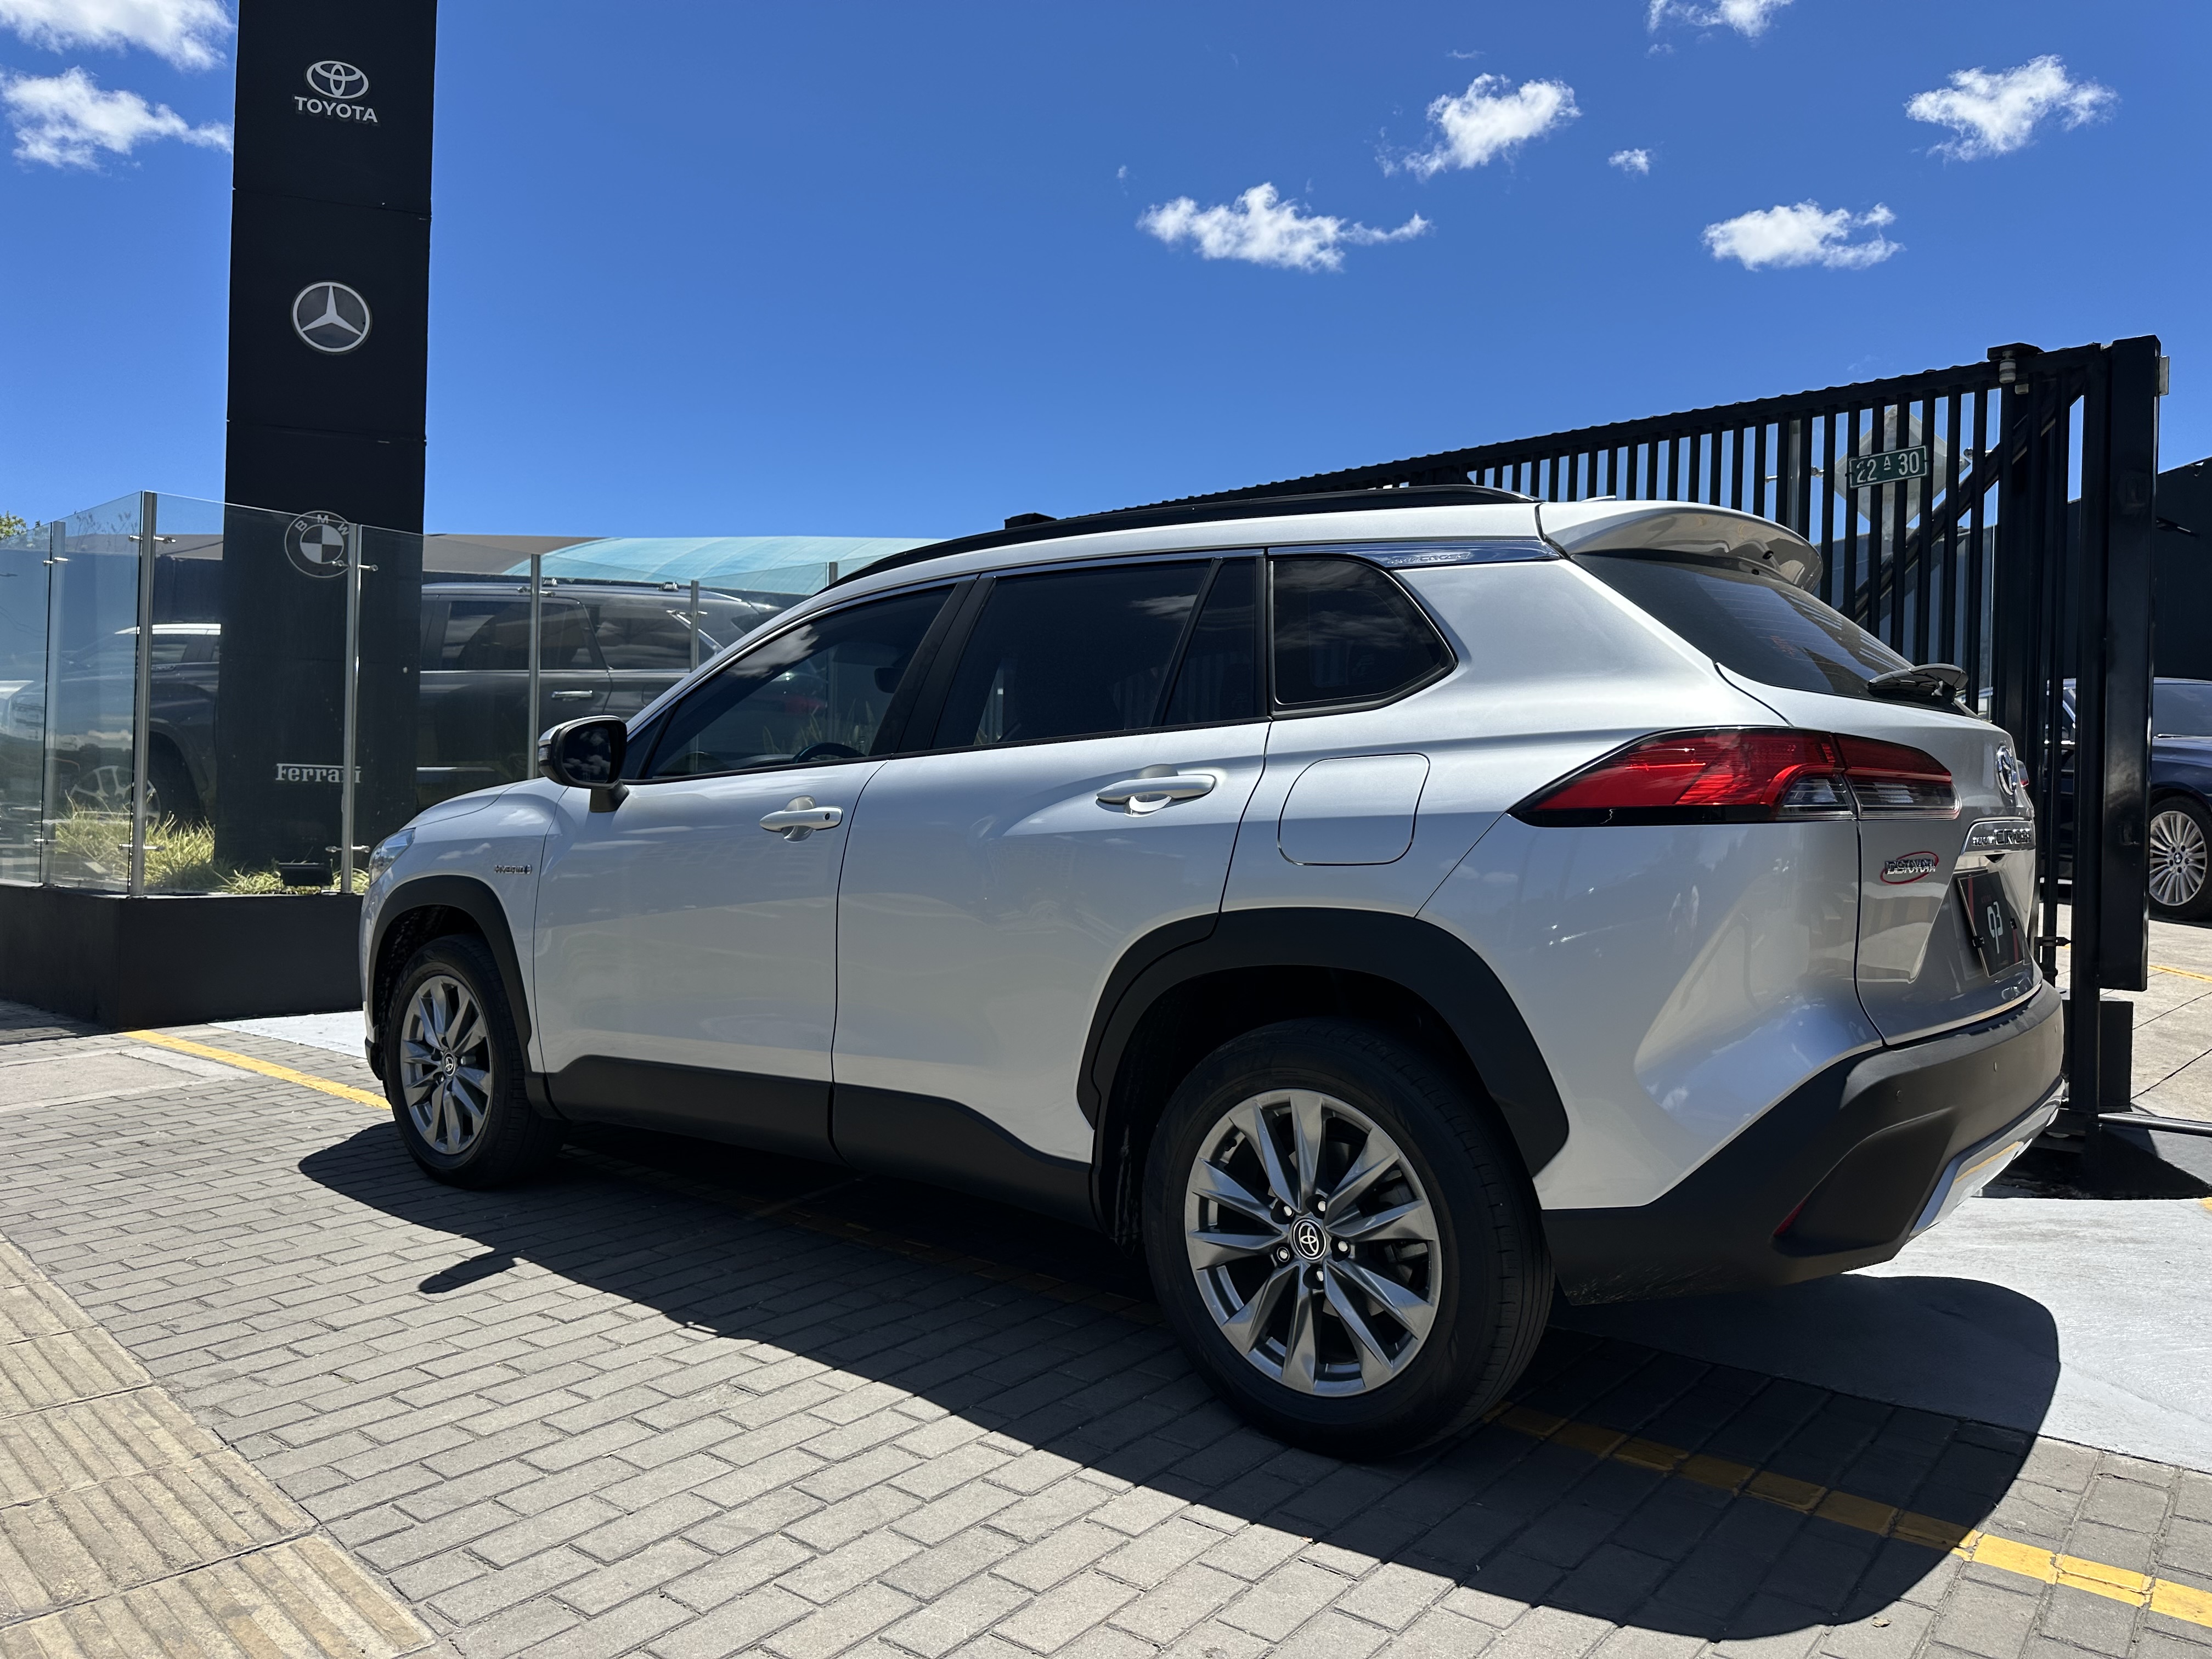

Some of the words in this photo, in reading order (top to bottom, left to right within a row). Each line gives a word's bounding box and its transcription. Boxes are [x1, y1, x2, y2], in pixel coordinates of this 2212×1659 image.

[294, 96, 378, 123] TOYOTA
[1856, 459, 1877, 483] 22
[1898, 451, 1920, 475] 30
[295, 514, 349, 535] BMW
[275, 763, 361, 783] Ferrai
